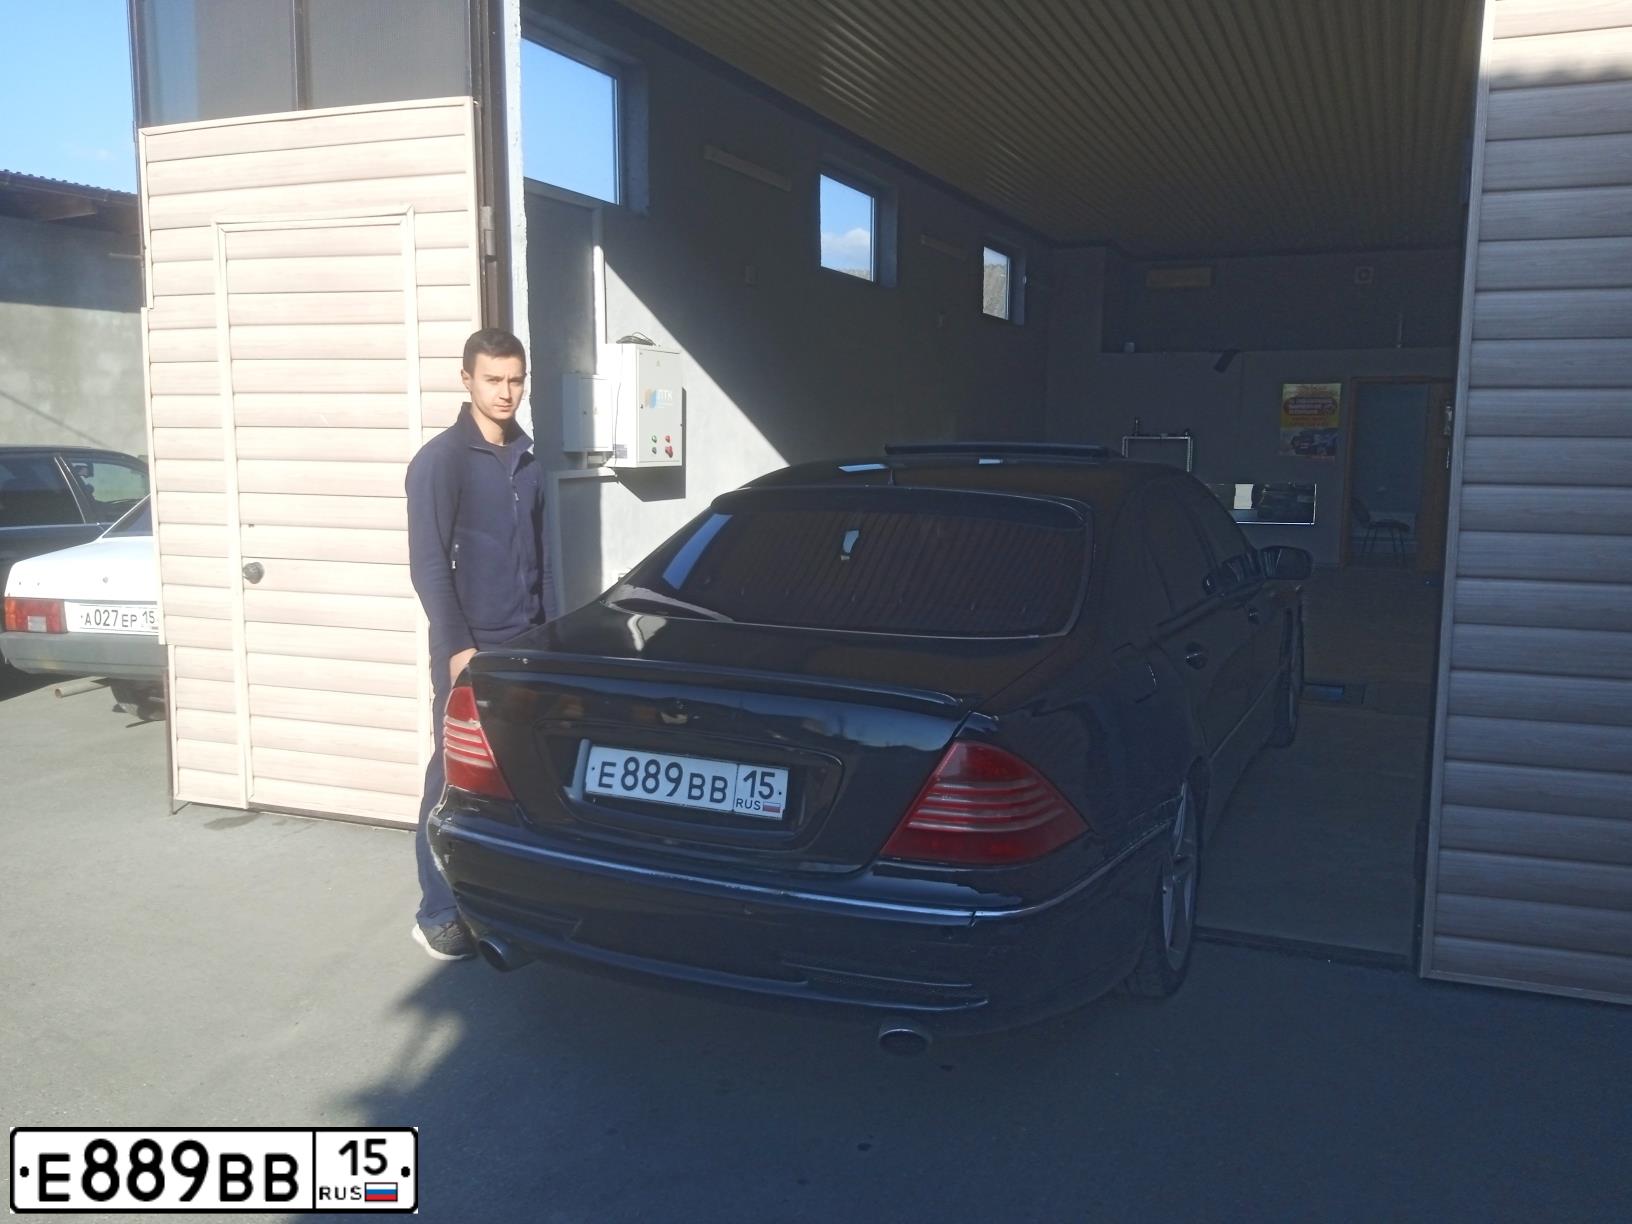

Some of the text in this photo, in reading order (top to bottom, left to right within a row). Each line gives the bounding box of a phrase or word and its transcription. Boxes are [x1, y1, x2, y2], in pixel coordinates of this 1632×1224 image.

[142, 610, 156, 624] 15
[598, 756, 776, 804] Е889ВВ 15
[736, 798, 762, 811] RUS
